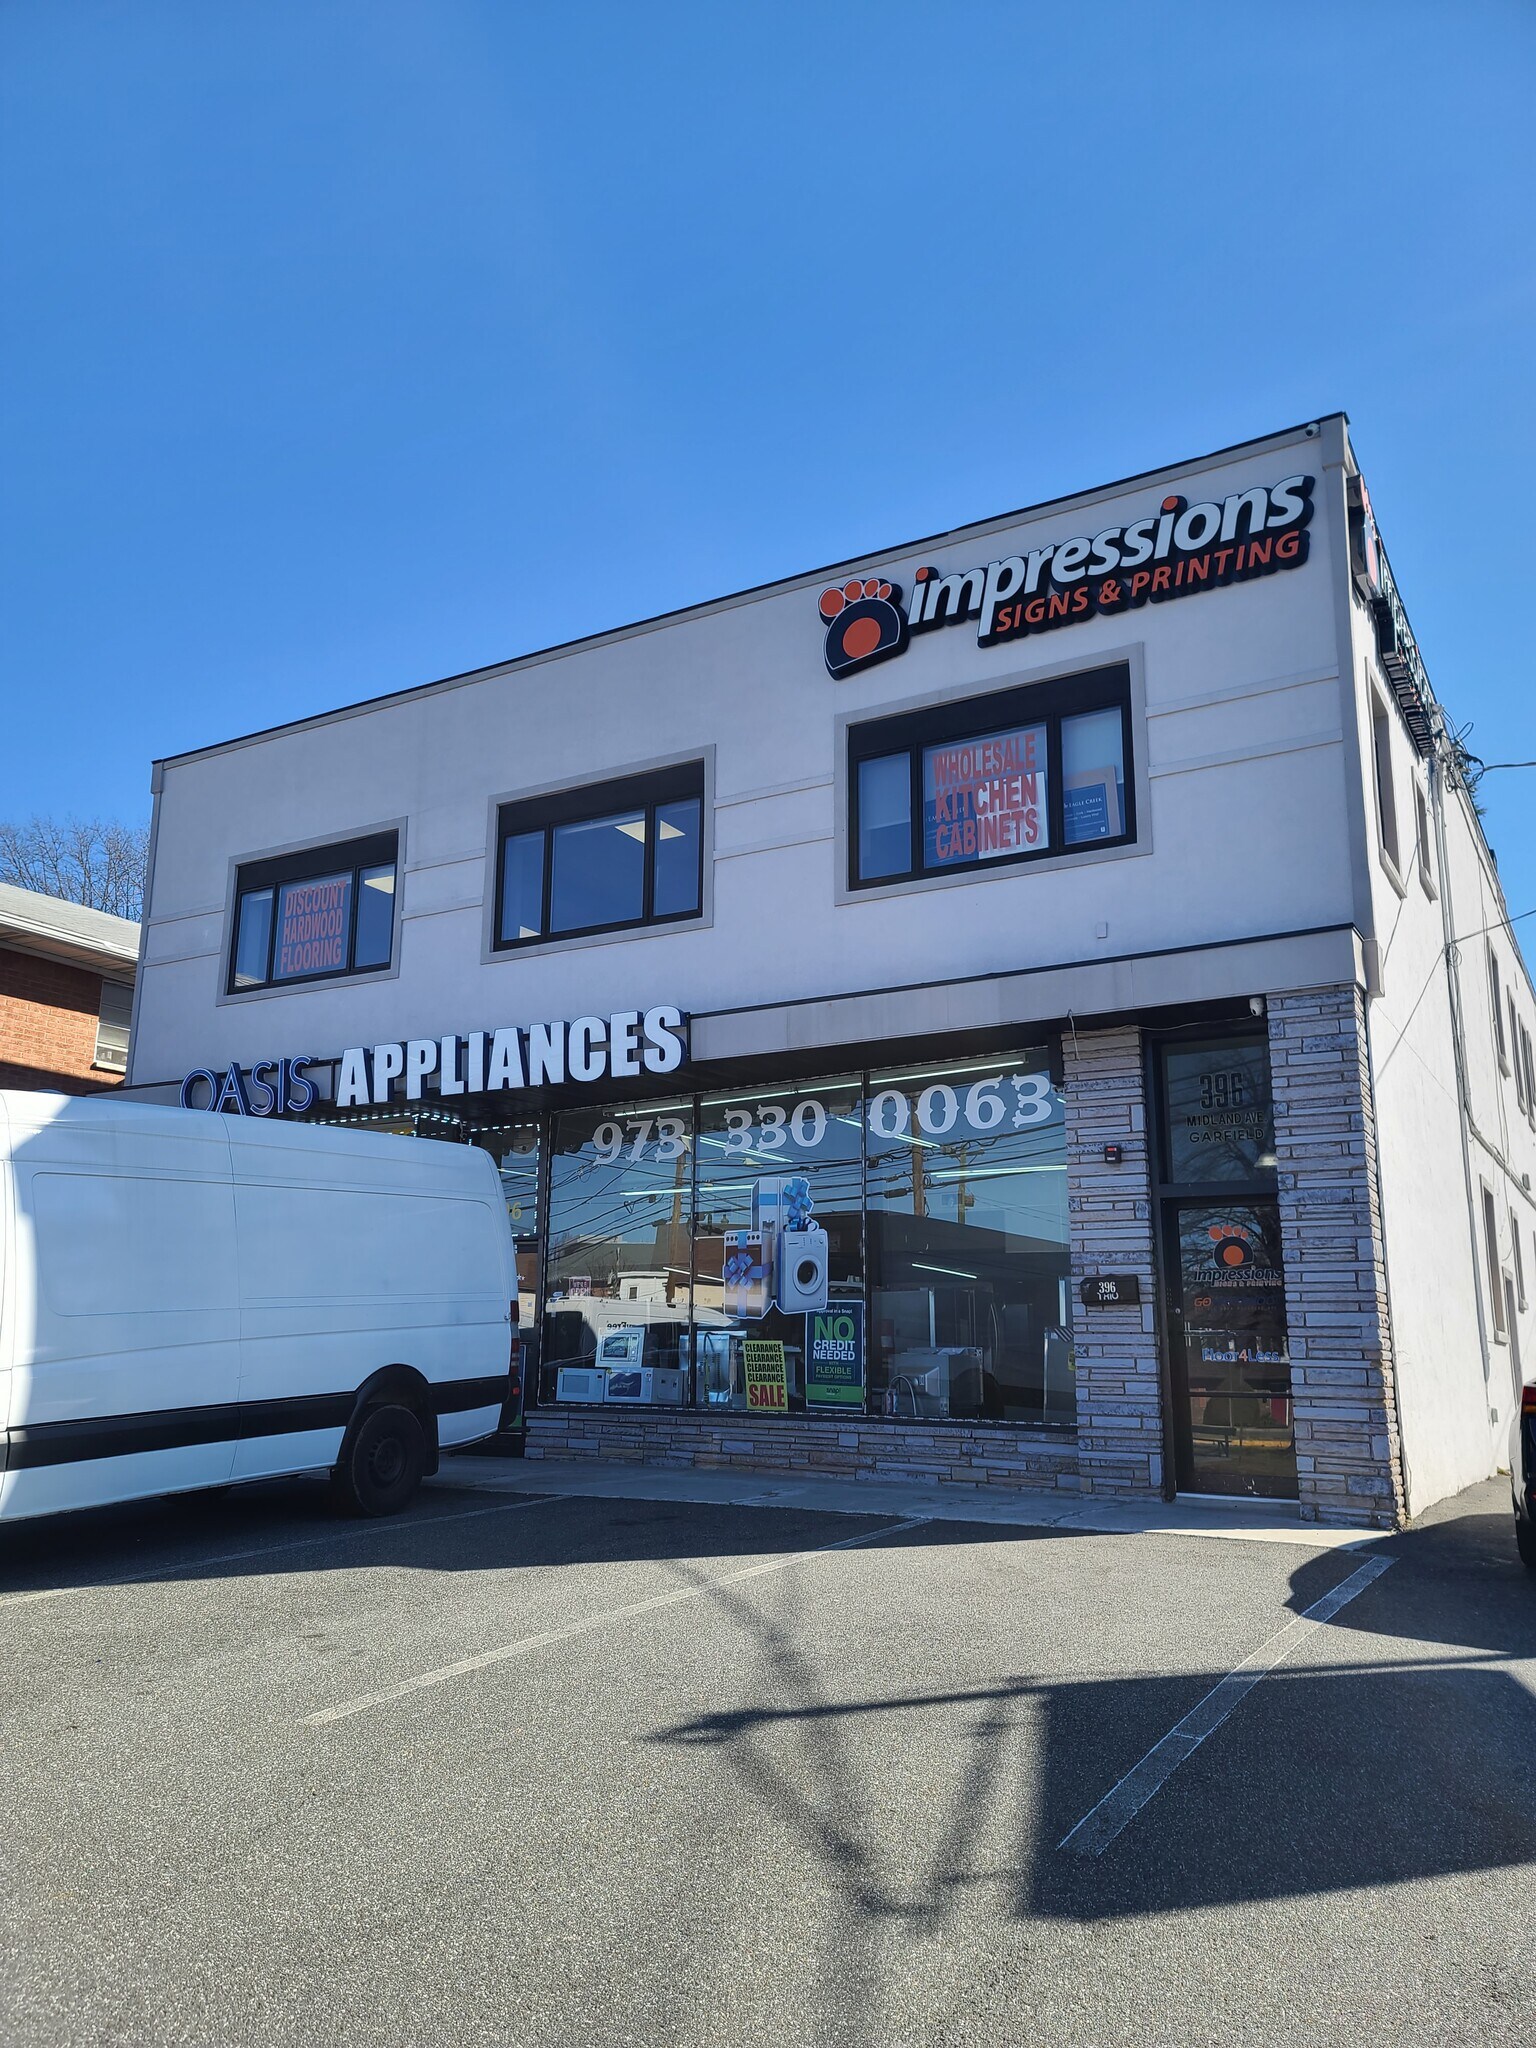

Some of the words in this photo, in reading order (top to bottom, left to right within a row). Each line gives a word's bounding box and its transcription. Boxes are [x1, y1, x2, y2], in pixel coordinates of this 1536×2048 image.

[907, 475, 1307, 638] impressions
[996, 586, 1089, 632] SIGNS
[1099, 579, 1122, 604] &
[1131, 531, 1300, 597] PRINTING
[933, 734, 1036, 787] WHOLESALE
[935, 771, 1037, 823] KITCHEN
[936, 808, 1038, 859] CABINETS
[284, 880, 347, 917] DISCOUNT
[282, 908, 343, 945] HARDWOOD
[280, 937, 342, 974] FLOORING
[180, 1055, 319, 1117] OASIS
[336, 1005, 688, 1108] APPLIANCES
[1199, 1071, 1244, 1109] 396
[592, 1115, 688, 1167] 973
[724, 1100, 828, 1158] 330
[868, 1073, 1053, 1140] 0063
[1186, 1113, 1242, 1127] MIDLAND
[1189, 1128, 1265, 1143] GARFIELD
[1098, 1281, 1117, 1293] 396
[1194, 1265, 1282, 1287] impressions
[814, 1316, 855, 1340] NO
[744, 1343, 782, 1353] CLEARANCE
[813, 1340, 856, 1351] CREDIT
[813, 1351, 856, 1361] NEEDED
[746, 1353, 783, 1363] CLEARANCE
[747, 1363, 784, 1373] CLEARANCE
[747, 1373, 785, 1383] CLEARANCE
[815, 1366, 852, 1375] FLEXIBLE
[748, 1384, 785, 1407] SALE
